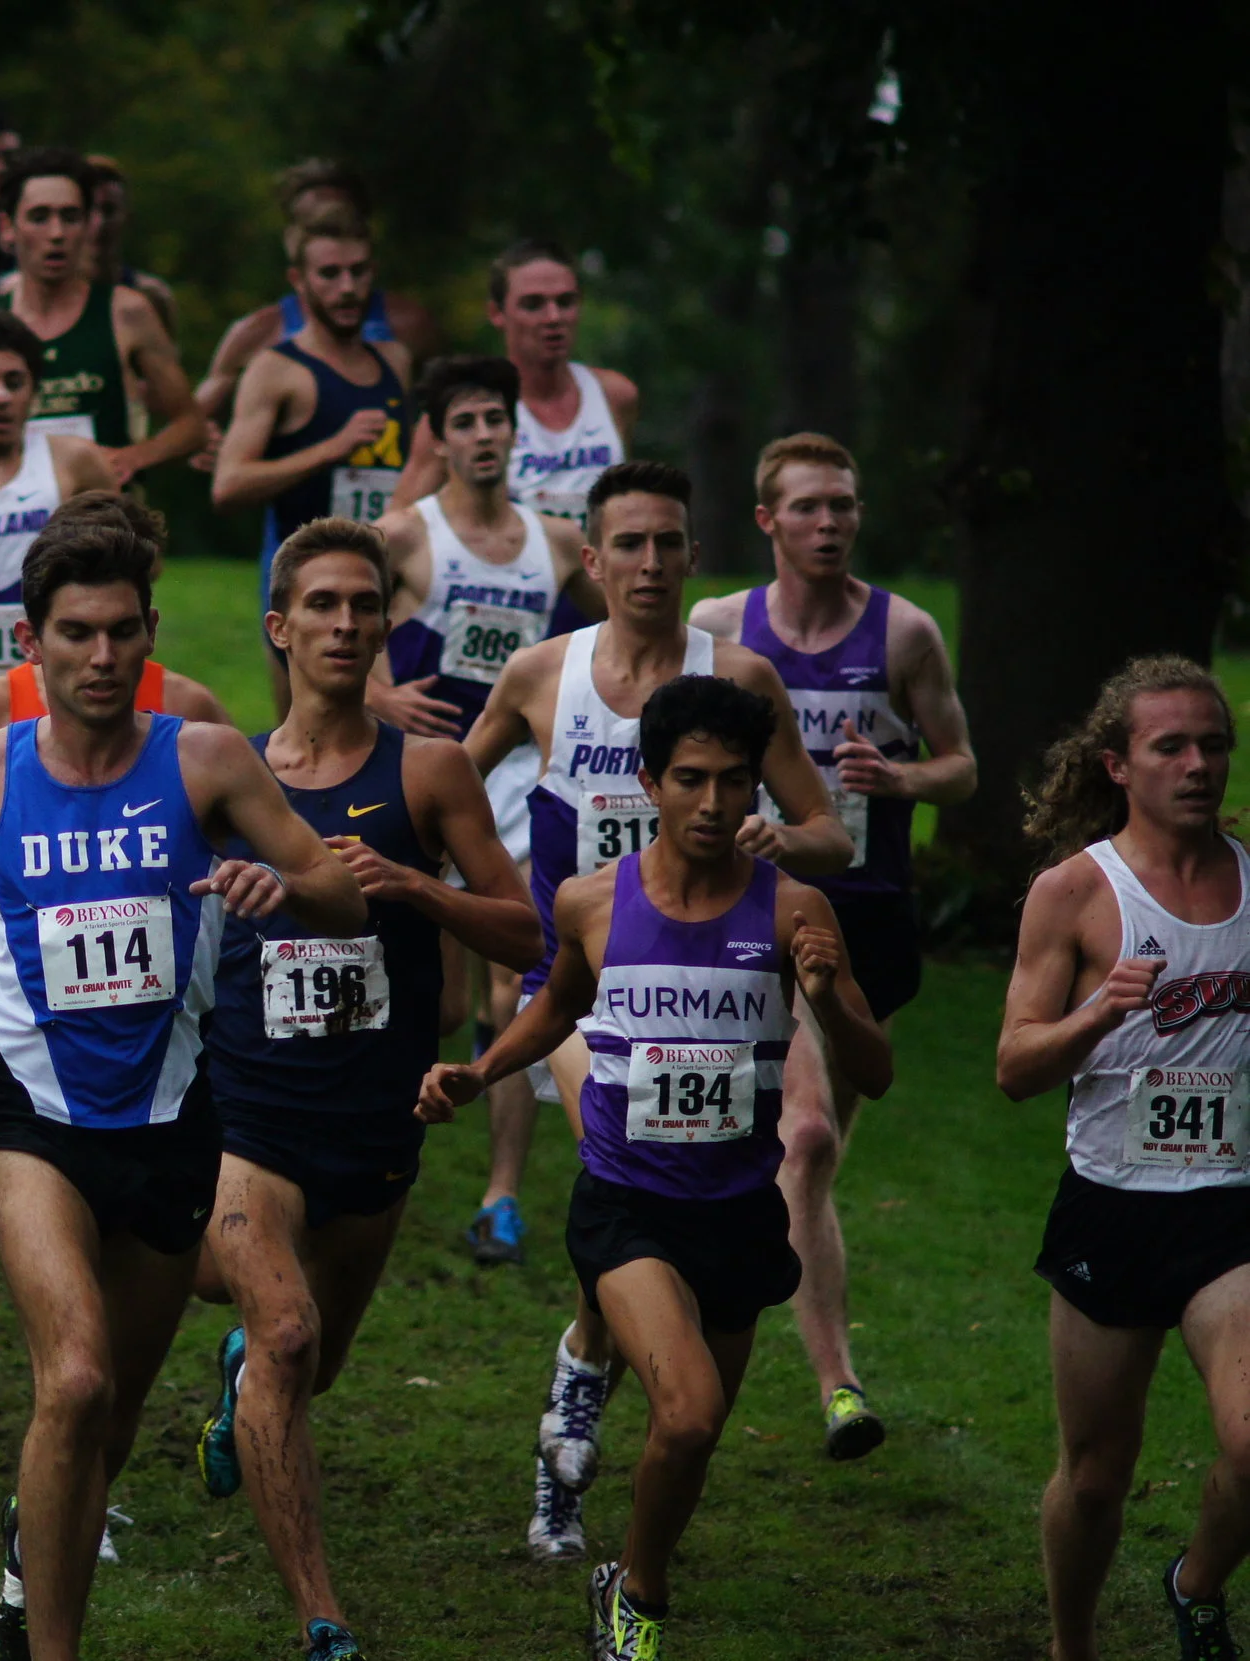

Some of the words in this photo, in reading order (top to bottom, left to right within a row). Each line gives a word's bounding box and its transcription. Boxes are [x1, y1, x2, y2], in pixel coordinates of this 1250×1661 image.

[353, 490, 391, 520] 19
[444, 585, 546, 613] PORTLAND
[797, 708, 877, 733] MAN
[569, 744, 641, 777] PORT
[610, 796, 651, 809] BEYN
[21, 826, 169, 877] DUKE
[77, 902, 148, 922] BEYNON
[67, 927, 152, 979] 114
[298, 942, 365, 957] BEYNON
[726, 941, 772, 951] BROOKS
[65, 985, 80, 994] ROY
[82, 983, 105, 993] GRIAK
[108, 980, 132, 990] INVITE
[287, 965, 366, 1011] 196
[607, 987, 766, 1021] FURMAN
[667, 1049, 735, 1062] BEYNON
[1166, 1072, 1233, 1086] BEYNON
[653, 1073, 732, 1115] 134
[645, 1119, 659, 1128] ROY
[662, 1119, 684, 1128] GRIAK
[686, 1119, 710, 1128] INVITE
[1150, 1095, 1225, 1140] 341
[1143, 1143, 1158, 1151] ROY
[1161, 1144, 1183, 1152] GRIAK
[1185, 1144, 1207, 1153] INVITE
